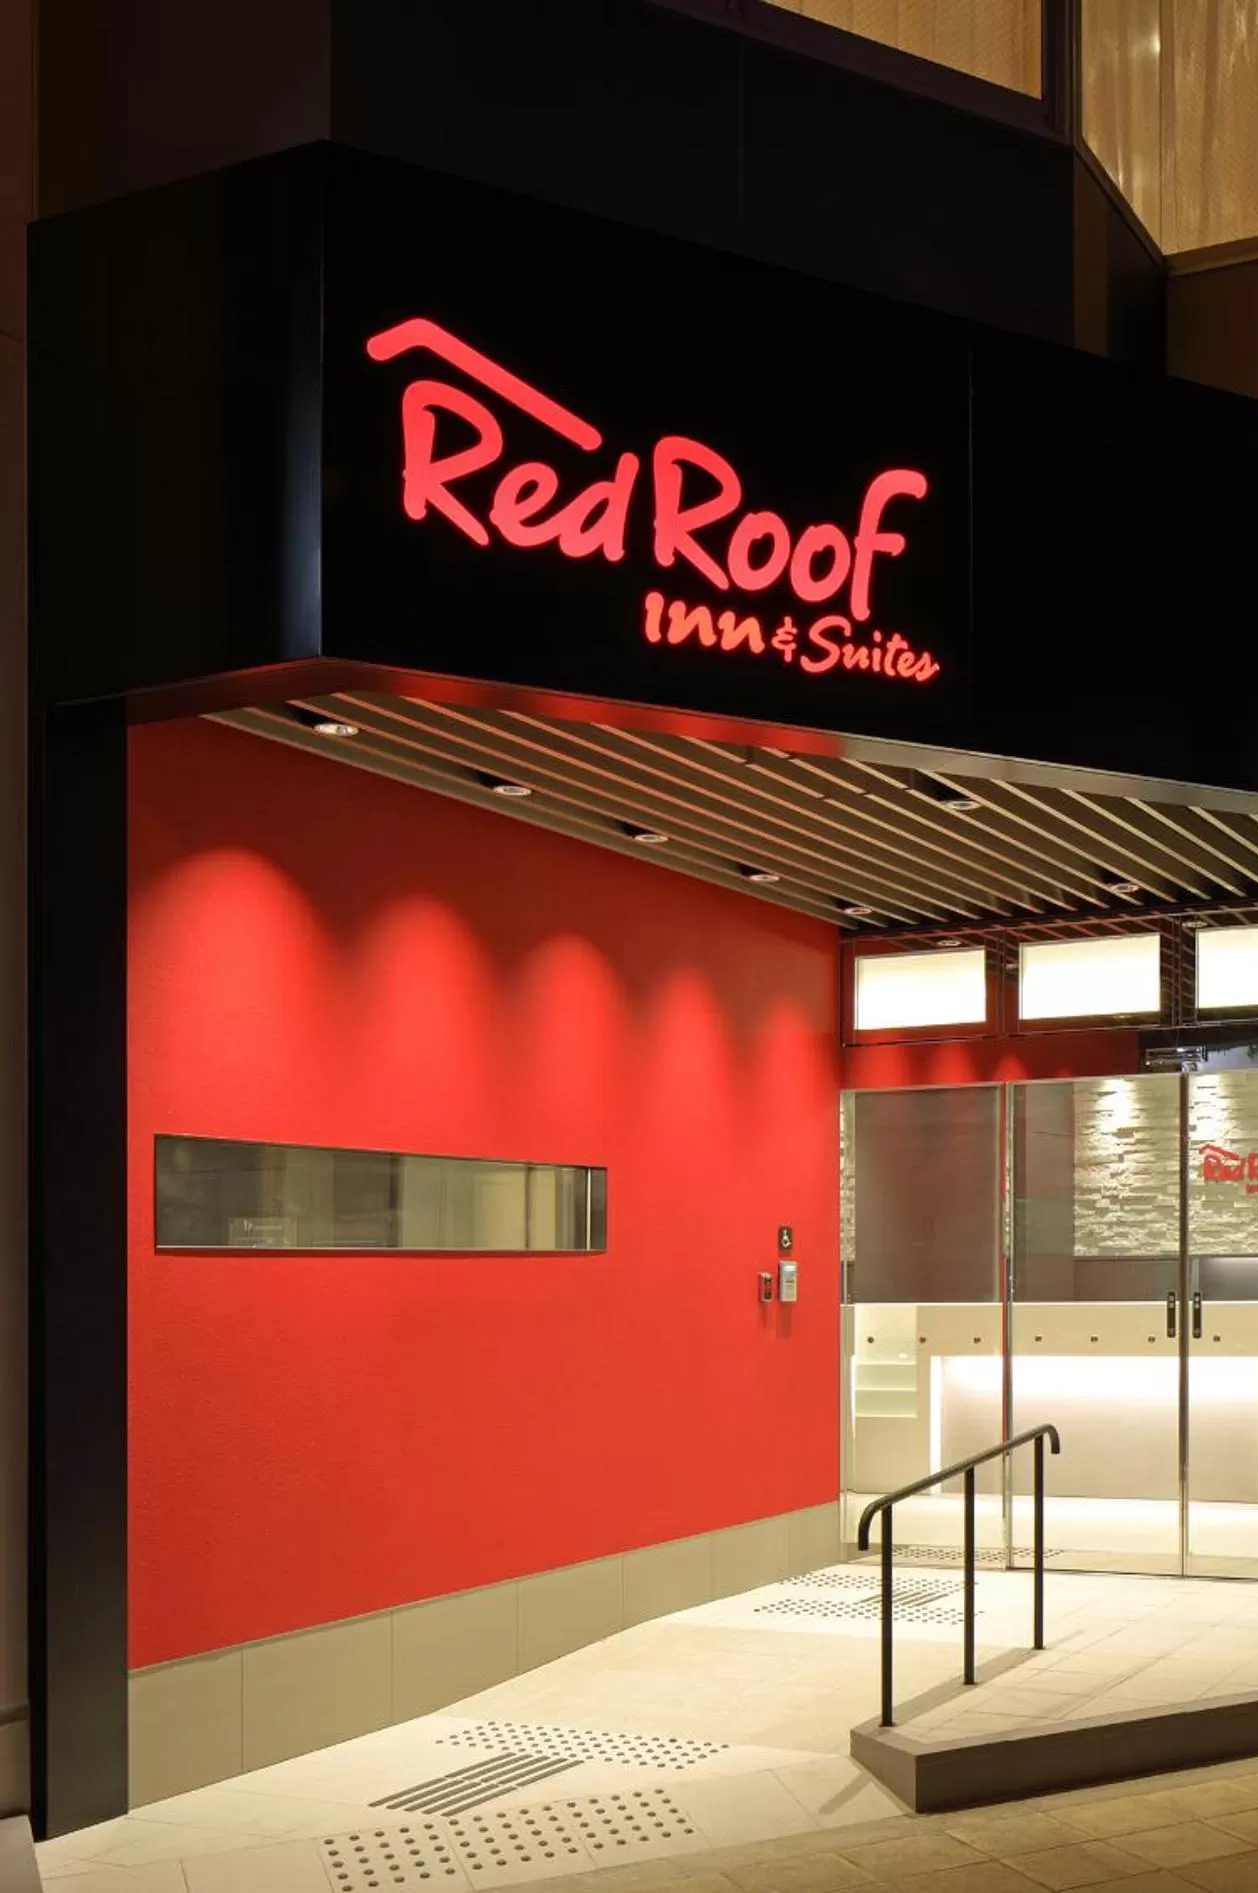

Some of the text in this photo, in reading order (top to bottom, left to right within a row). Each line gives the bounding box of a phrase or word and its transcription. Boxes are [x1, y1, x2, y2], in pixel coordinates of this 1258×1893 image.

[402, 380, 928, 622] Red Roof
[644, 591, 766, 654] Inn
[799, 614, 940, 682] Suites
